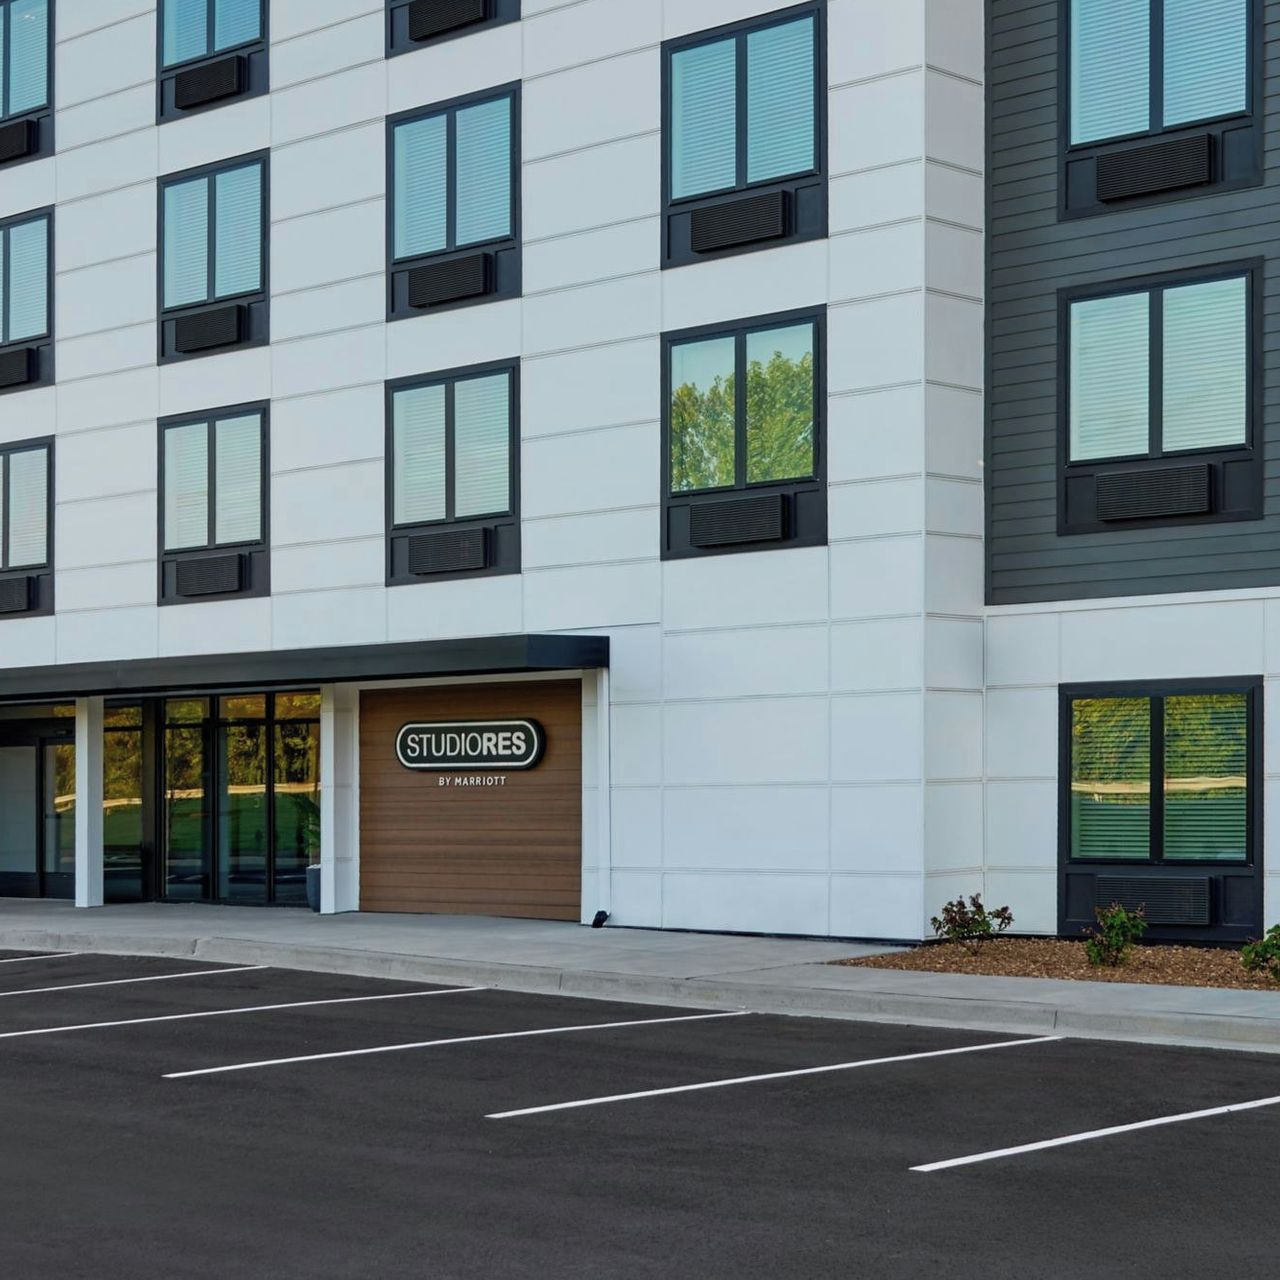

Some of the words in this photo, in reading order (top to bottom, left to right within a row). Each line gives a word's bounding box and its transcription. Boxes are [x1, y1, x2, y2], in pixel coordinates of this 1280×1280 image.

[407, 731, 526, 757] STUDIORES
[439, 777, 451, 786] BY
[454, 776, 506, 786] MARRIOTT
